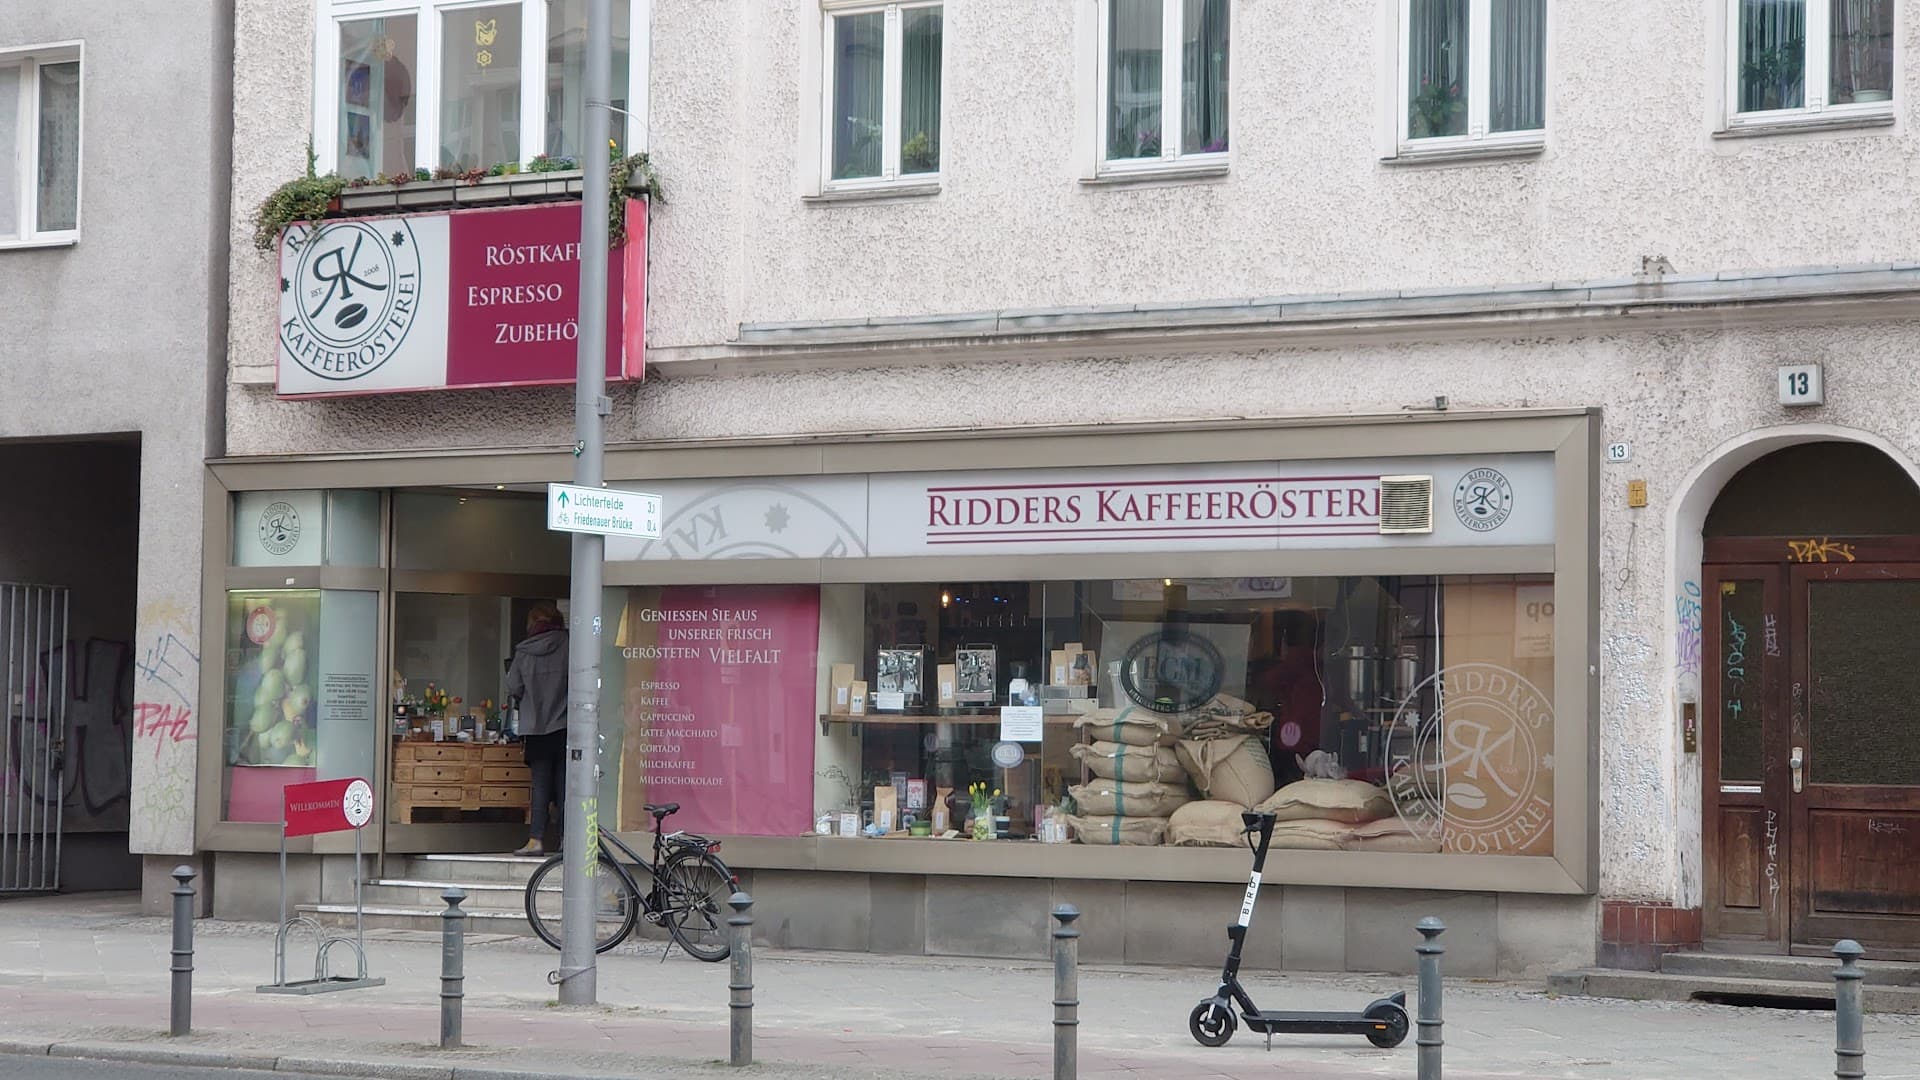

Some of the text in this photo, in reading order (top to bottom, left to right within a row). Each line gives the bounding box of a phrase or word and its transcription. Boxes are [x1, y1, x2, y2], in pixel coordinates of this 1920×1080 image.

[468, 283, 562, 307] ESPRESSO
[282, 271, 415, 374] KAFFEERÖSTEREI
[495, 318, 579, 344] ZUBEHÖ
[1788, 372, 1809, 395] 13
[1610, 445, 1625, 458] 13
[1467, 470, 1505, 488] RIDDERS
[574, 493, 624, 511] Lichterfelde
[927, 494, 1082, 527] RIDDERS
[574, 512, 610, 528] Friedenauer
[612, 516, 633, 530] Brücke
[640, 607, 758, 622] GENIESSEN SIE AUS
[668, 628, 772, 641] UNSERER FRISCH
[622, 644, 782, 665] GERÖSTETEN VIELFALT
[640, 681, 680, 690] ESPRESSO
[640, 697, 669, 706] KAFFEE
[1438, 671, 1550, 730] RIDDERS
[640, 713, 695, 722] CAPPUCCINO
[640, 728, 718, 738] LATTE MACCHIATO
[640, 744, 681, 753] CORTADO
[639, 759, 696, 769] MILCHKAFFEE
[639, 776, 724, 786] MILCHSCHOKOLADE
[289, 799, 340, 813] WILLKOMMEN
[1392, 752, 1552, 855] KAFFEERÖSTEREI
[1242, 876, 1256, 915] BIRD
